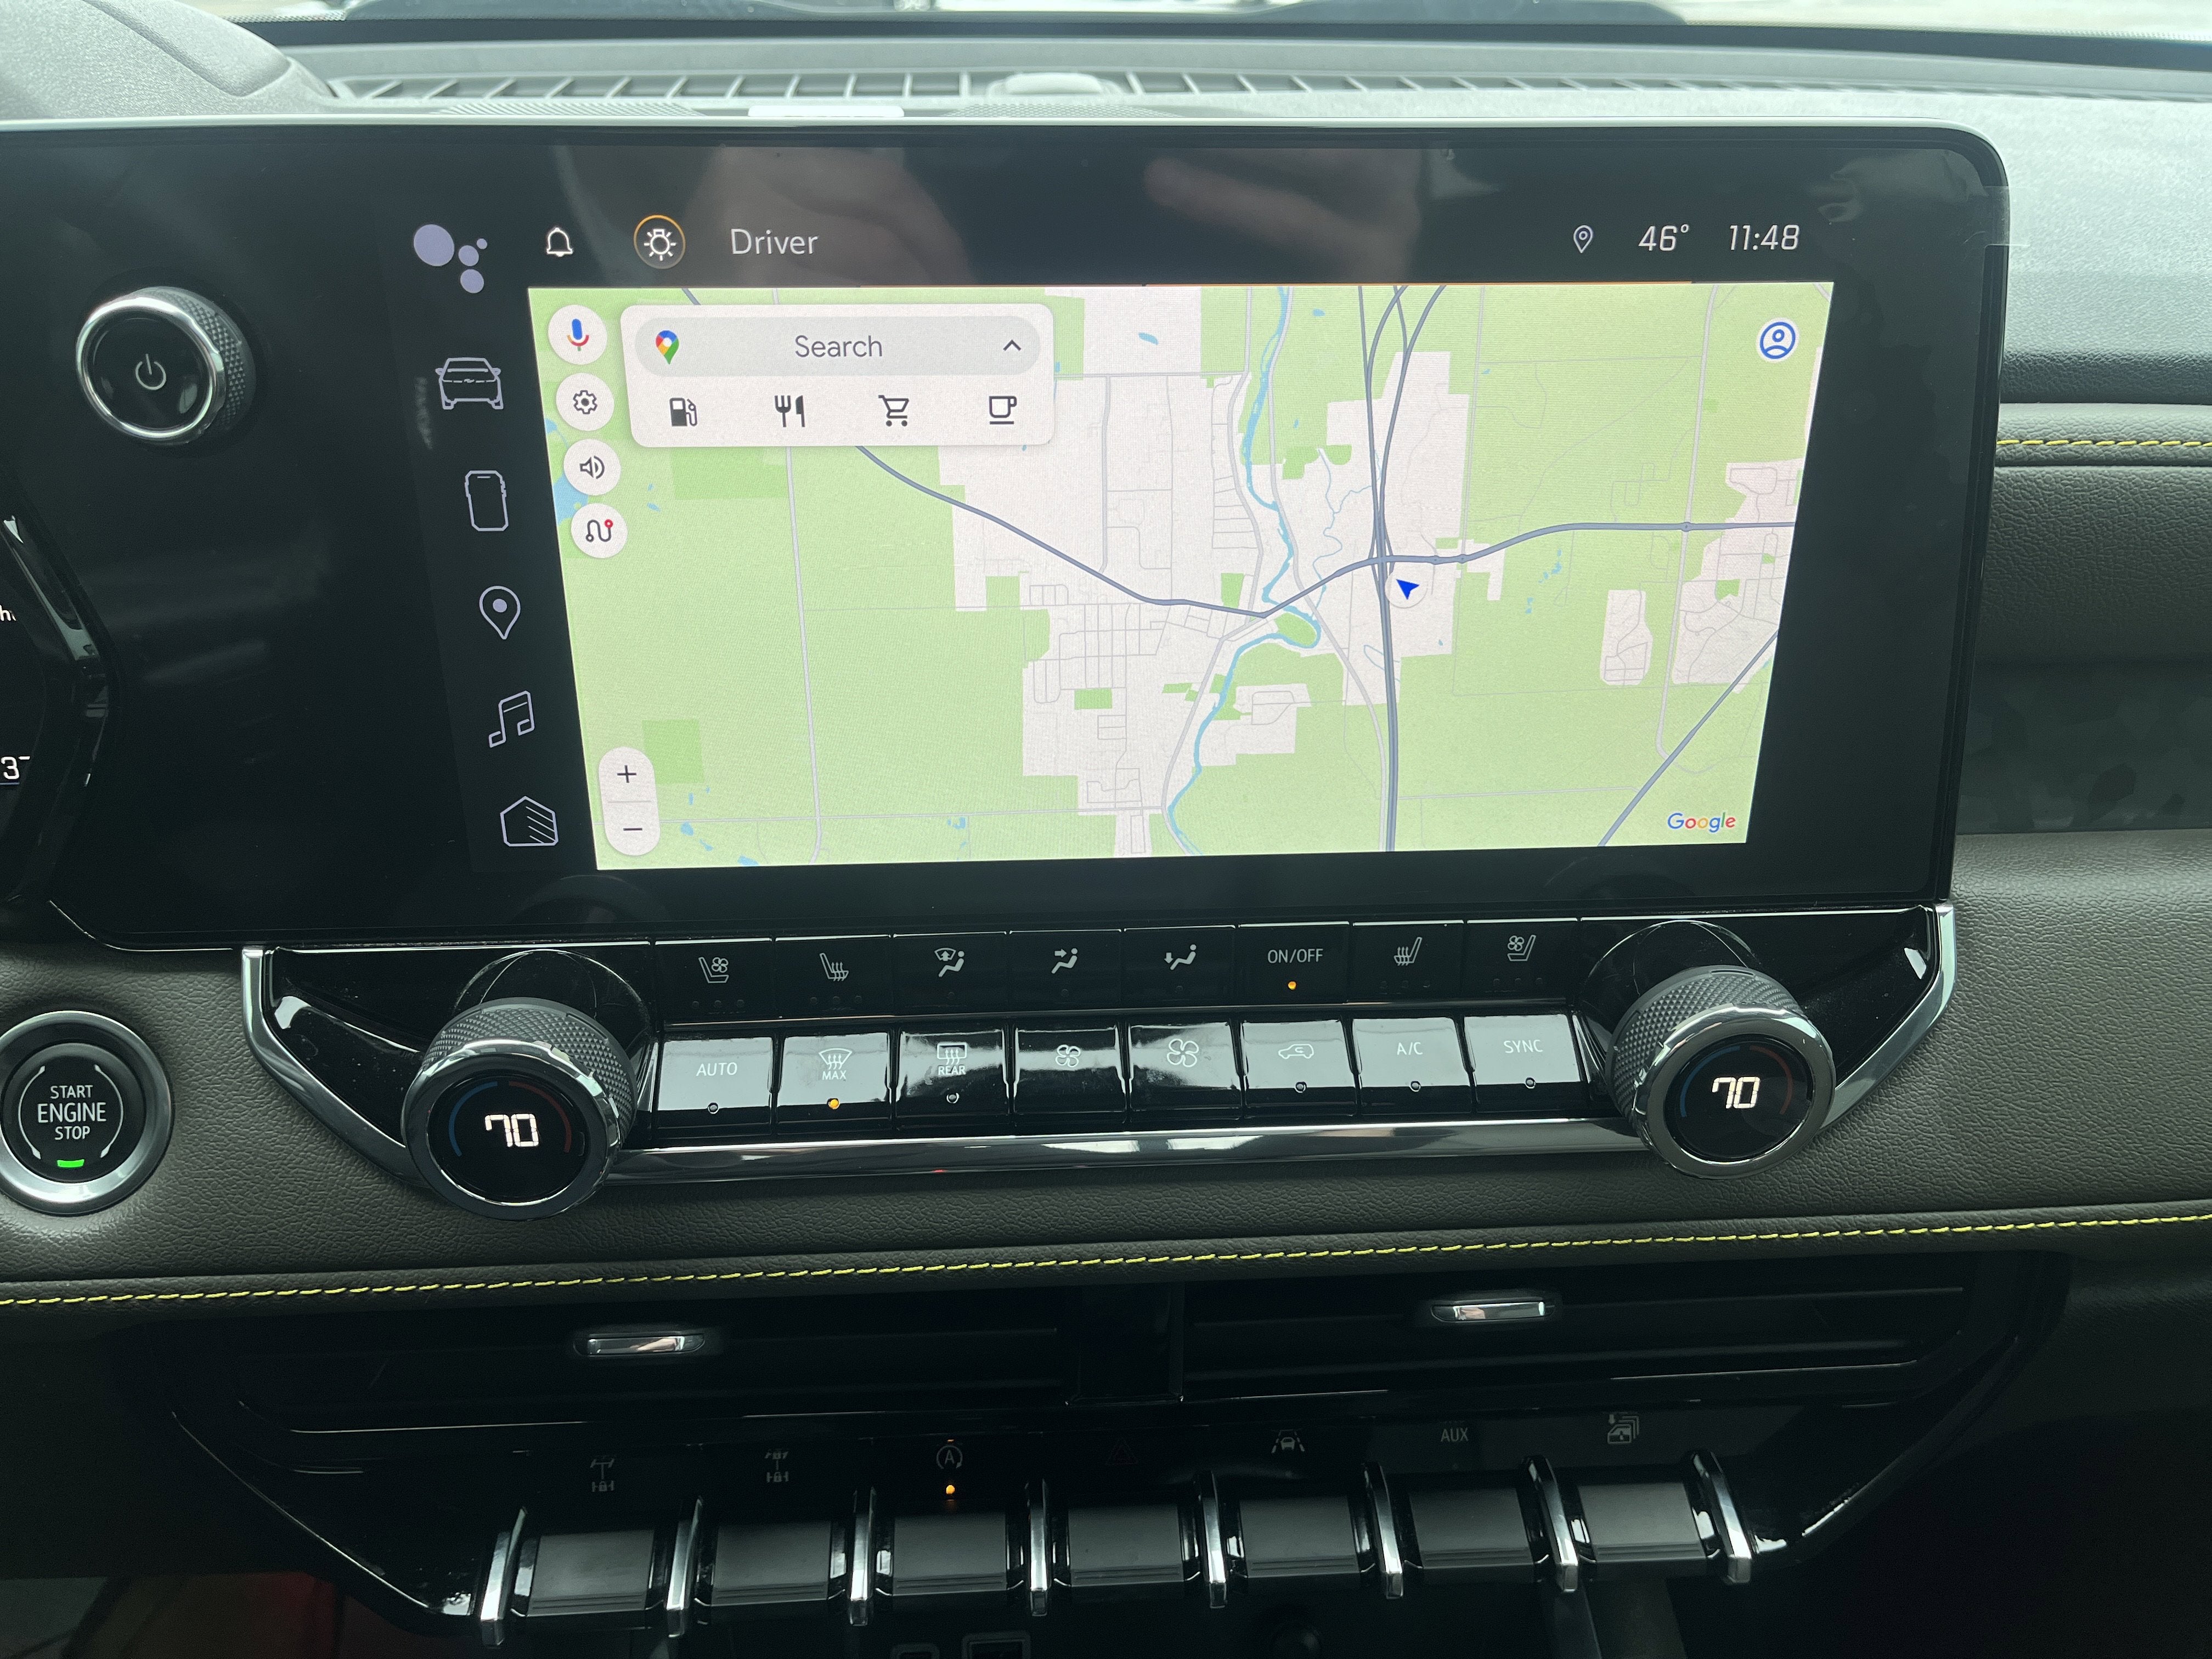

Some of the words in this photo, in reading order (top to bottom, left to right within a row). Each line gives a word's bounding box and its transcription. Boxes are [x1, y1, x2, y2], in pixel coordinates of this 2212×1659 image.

[730, 228, 818, 256] Driver
[1638, 224, 1690, 251] 46°
[1729, 224, 1801, 251] 11:48
[795, 335, 883, 358] Search
[1667, 812, 1736, 833] Google
[1267, 948, 1323, 964] ON/OFF
[1396, 1041, 1423, 1057] A/C
[1504, 1039, 1543, 1054] SYNC
[696, 1061, 738, 1077] AUTO
[822, 1069, 847, 1081] MAX
[938, 1065, 966, 1076] REAR
[50, 1085, 93, 1099] START
[1711, 1076, 1760, 1109] 70
[37, 1102, 107, 1123] ENGINE
[55, 1126, 91, 1140] STOP
[484, 1113, 539, 1147] 70
[1440, 1427, 1469, 1442] AUX
